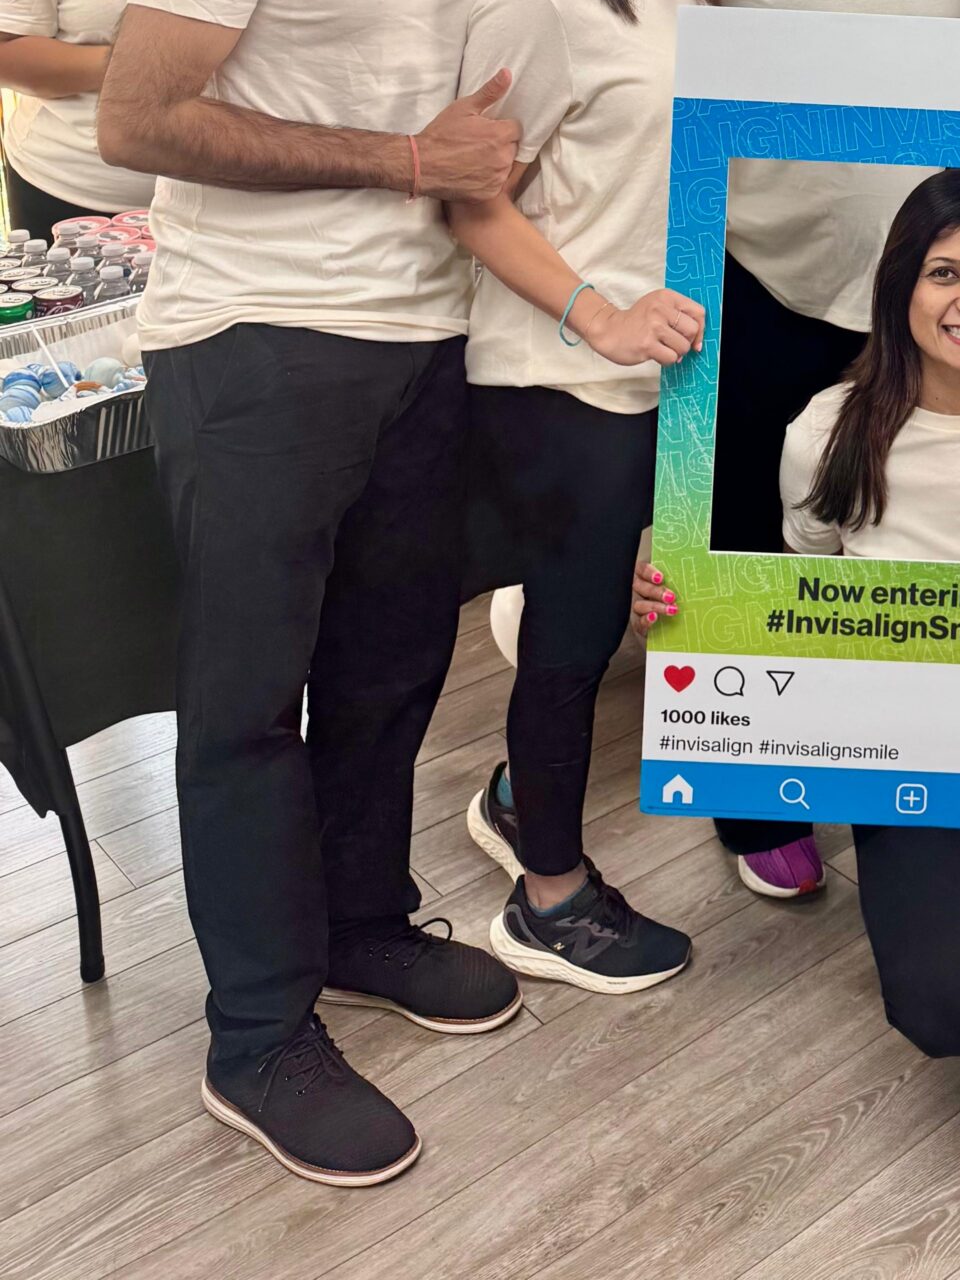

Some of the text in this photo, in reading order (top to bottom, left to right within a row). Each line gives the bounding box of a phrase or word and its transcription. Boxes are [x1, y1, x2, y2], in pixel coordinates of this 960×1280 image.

[798, 576, 865, 604] Now
[660, 709, 751, 727] 1000 likes
[659, 734, 899, 761] #invisalign #invisalignsmile
